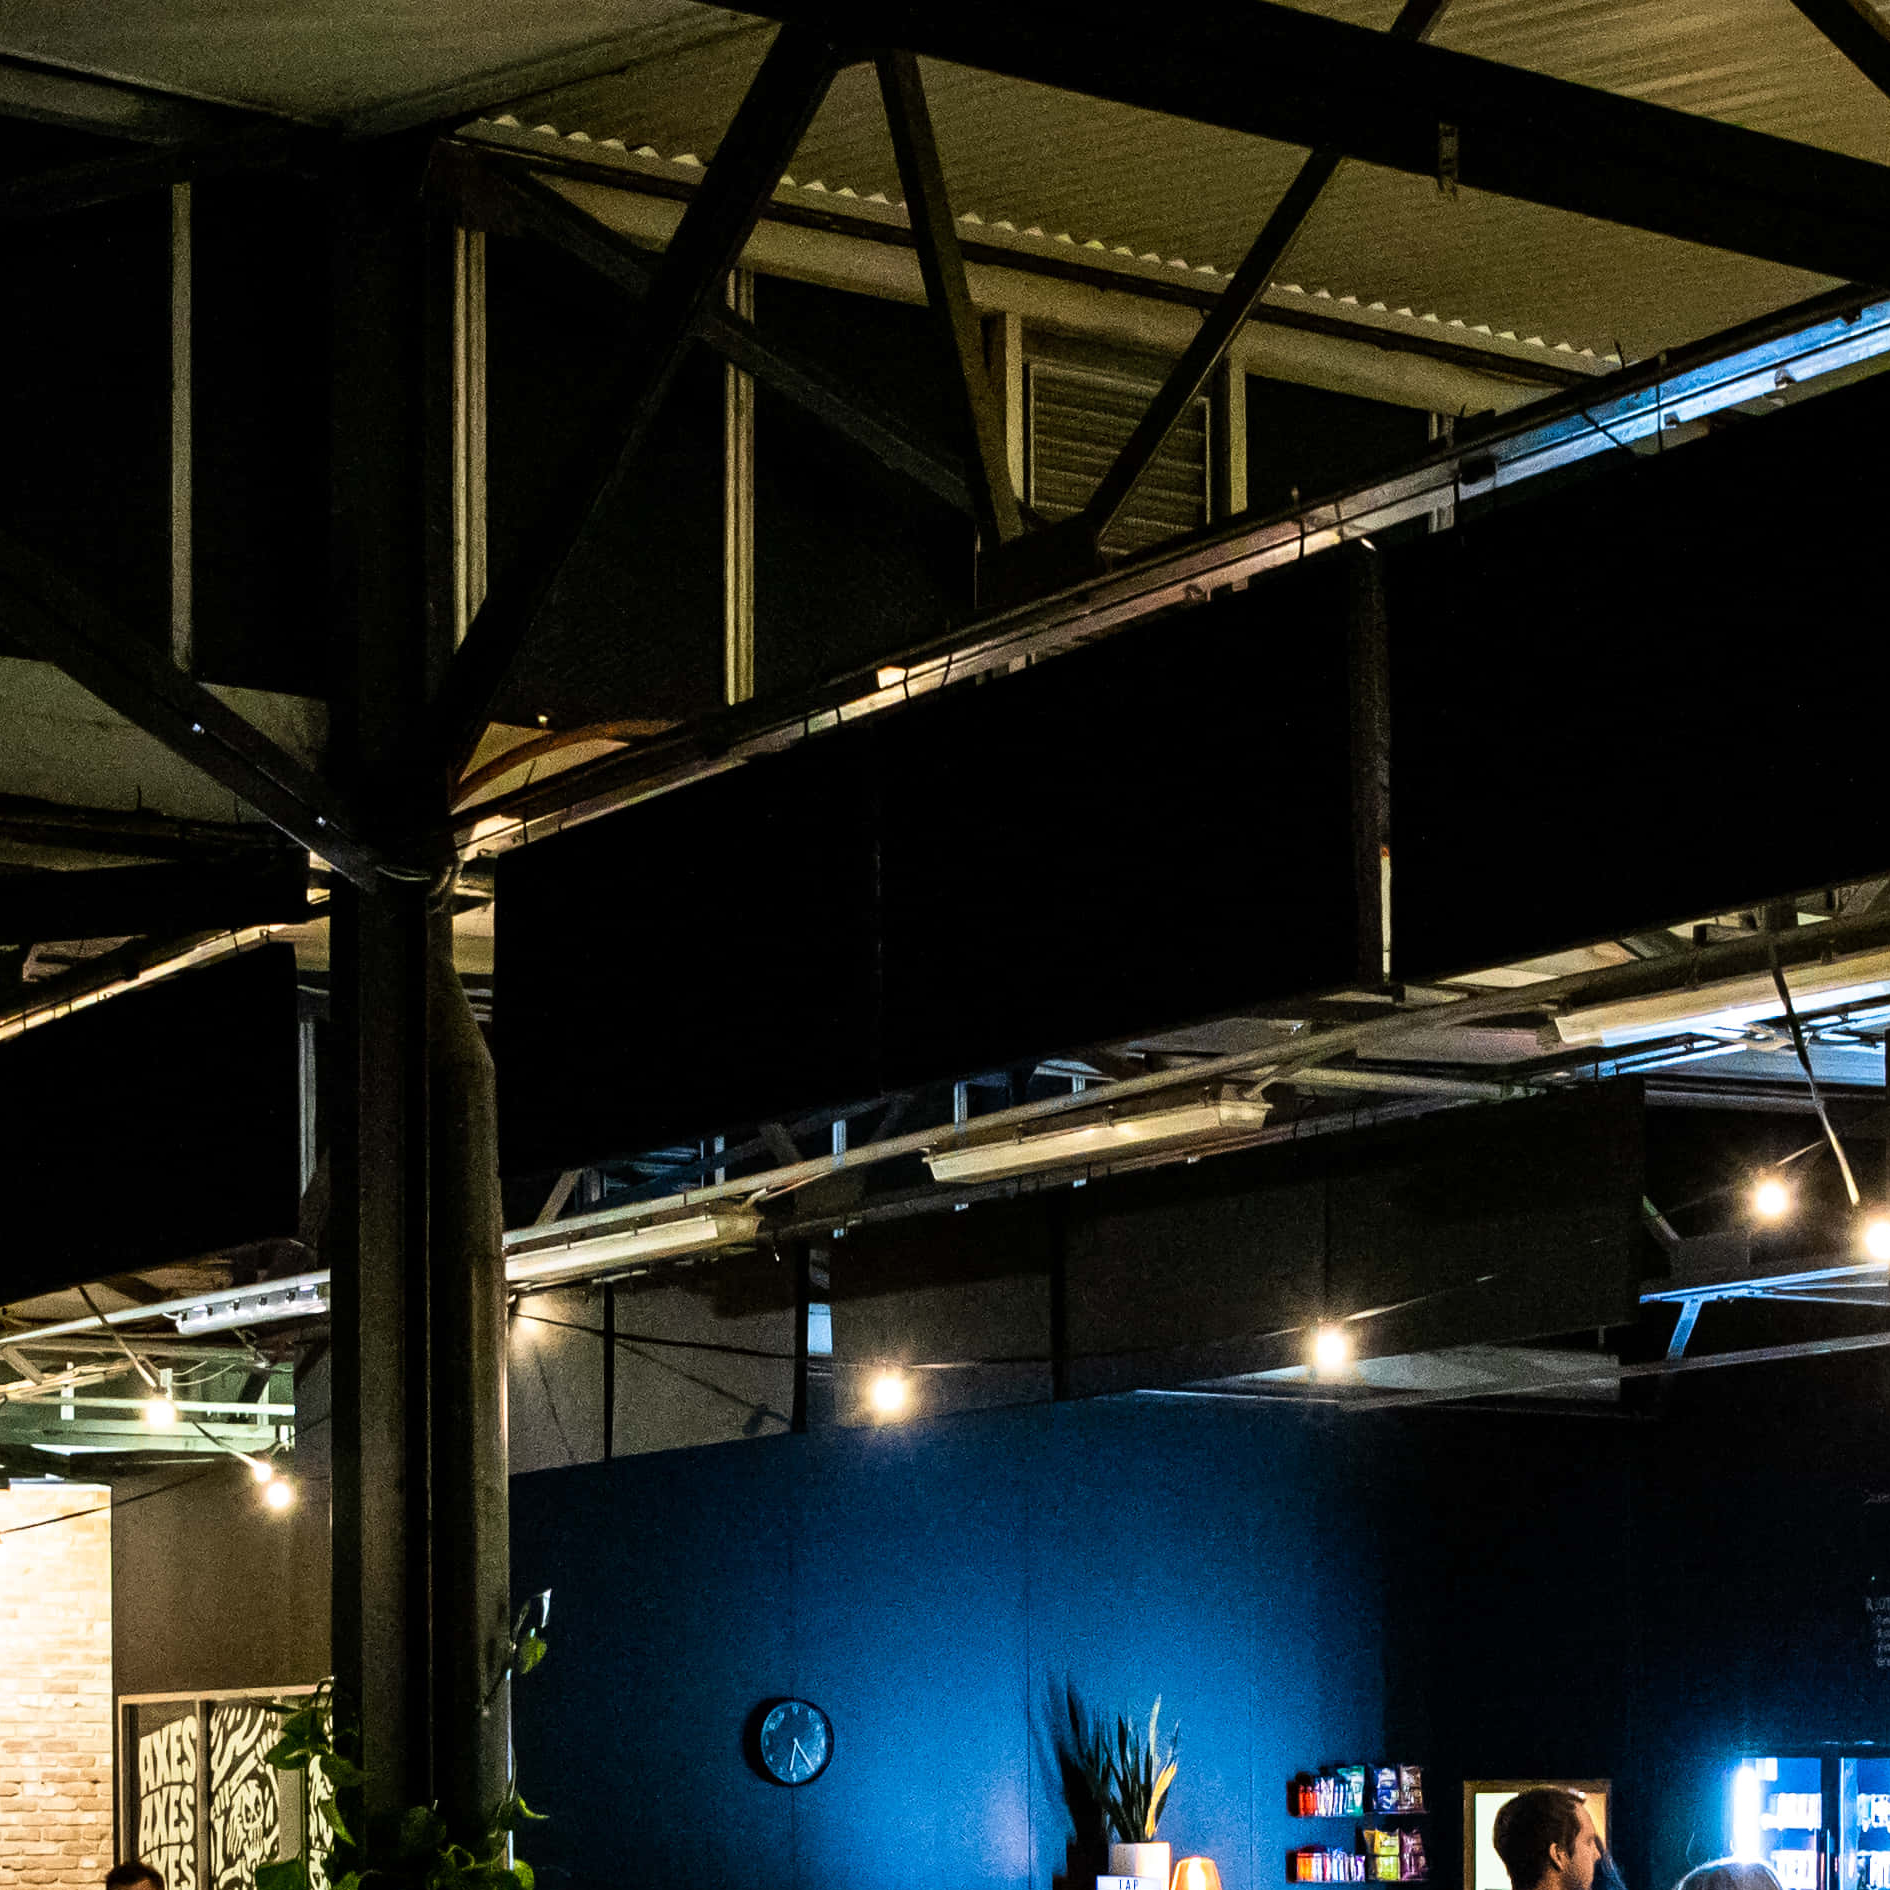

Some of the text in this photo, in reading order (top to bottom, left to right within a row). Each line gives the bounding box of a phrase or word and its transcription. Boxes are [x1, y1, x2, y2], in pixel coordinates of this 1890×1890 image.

[139, 1714, 198, 1798] AXES
[139, 1784, 196, 1864] AXES
[1117, 1879, 1140, 1890] TAP
